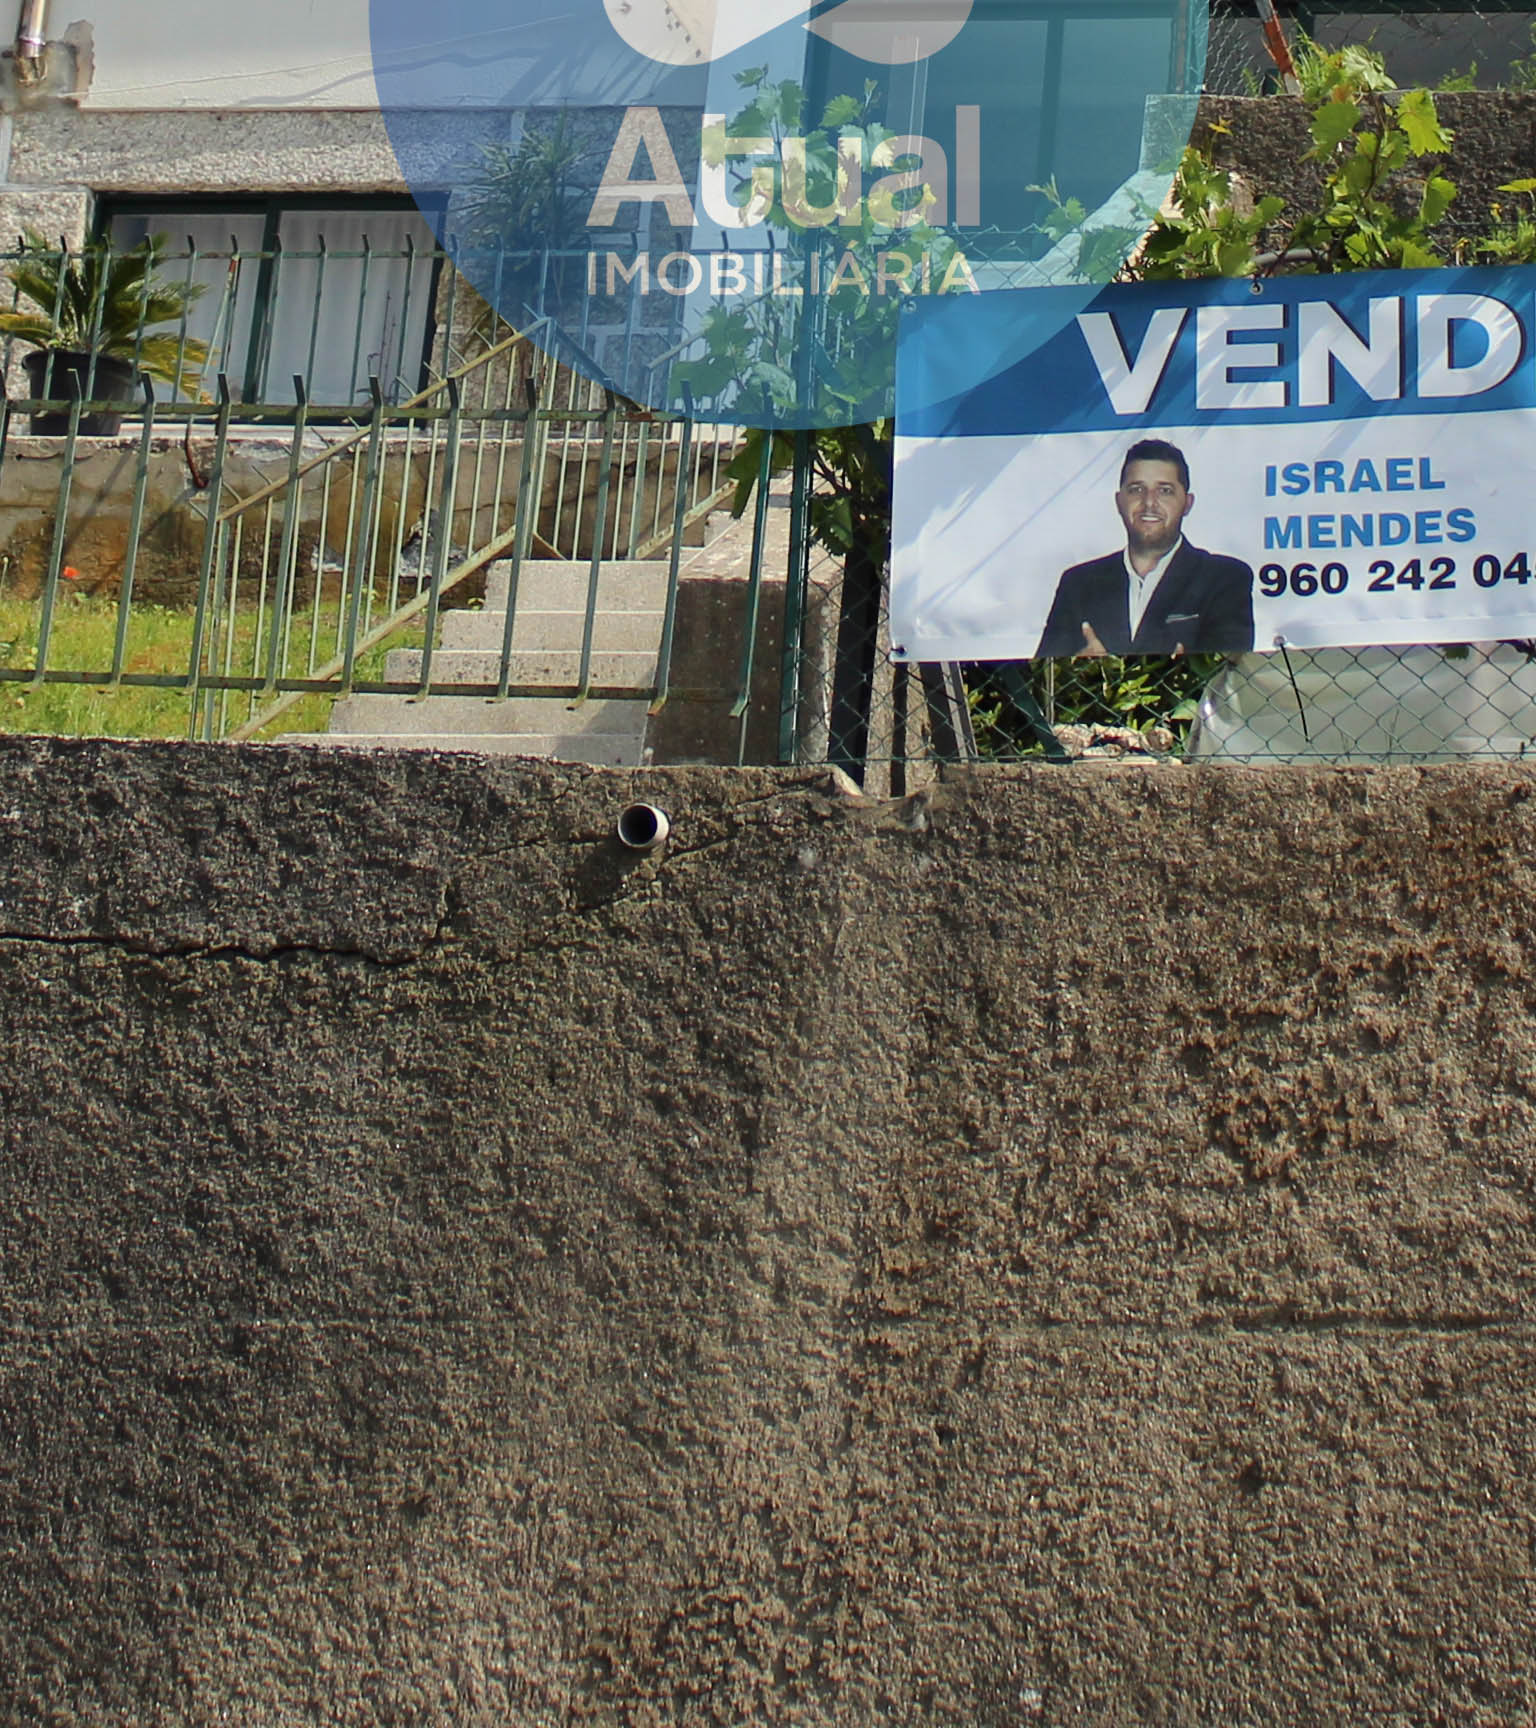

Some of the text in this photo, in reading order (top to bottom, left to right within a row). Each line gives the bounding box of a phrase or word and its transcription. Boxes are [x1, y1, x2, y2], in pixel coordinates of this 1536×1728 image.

[1264, 456, 1446, 497] ISRAEL
[1263, 508, 1477, 550] MENDES
[1258, 562, 1349, 598] 960
[1367, 556, 1457, 593] 242
